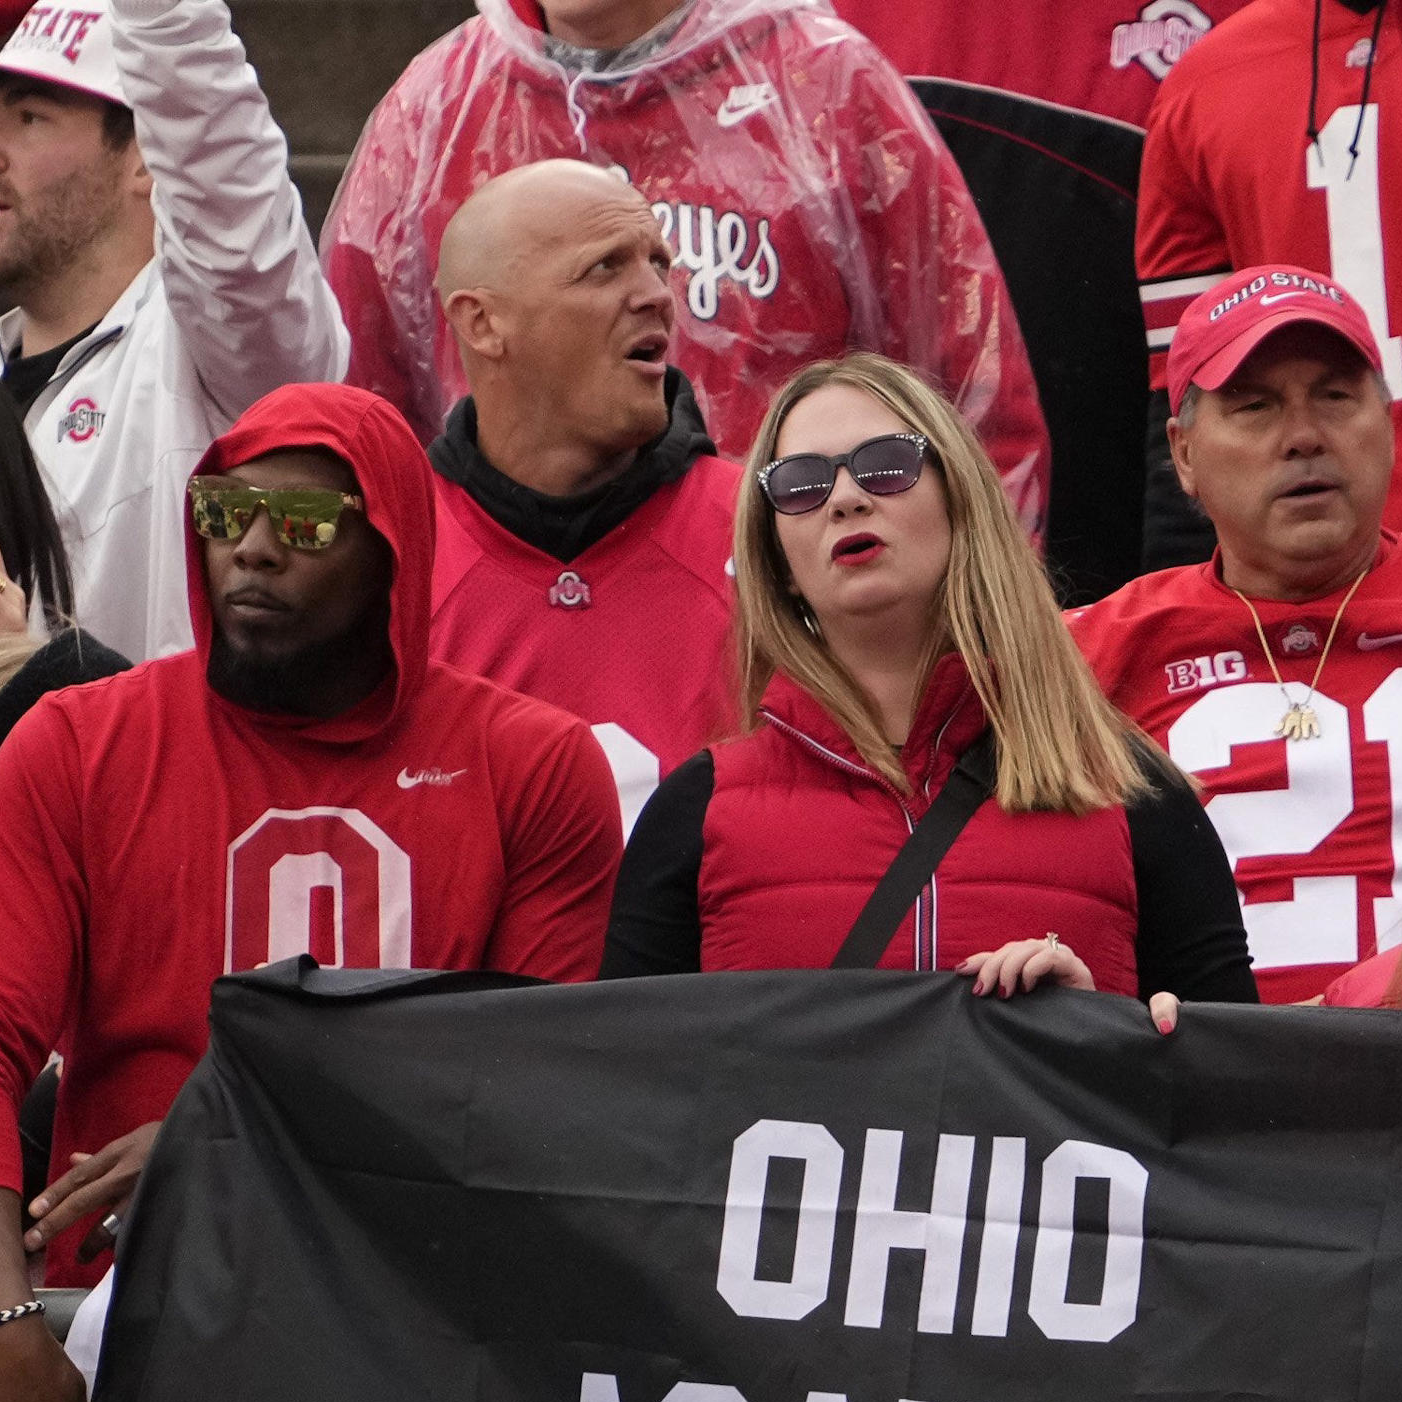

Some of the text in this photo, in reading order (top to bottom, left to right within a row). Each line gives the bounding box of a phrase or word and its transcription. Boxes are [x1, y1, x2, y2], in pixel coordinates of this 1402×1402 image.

[1209, 271, 1345, 322] OHIO STATE
[716, 1119, 1149, 1343] OHIO
